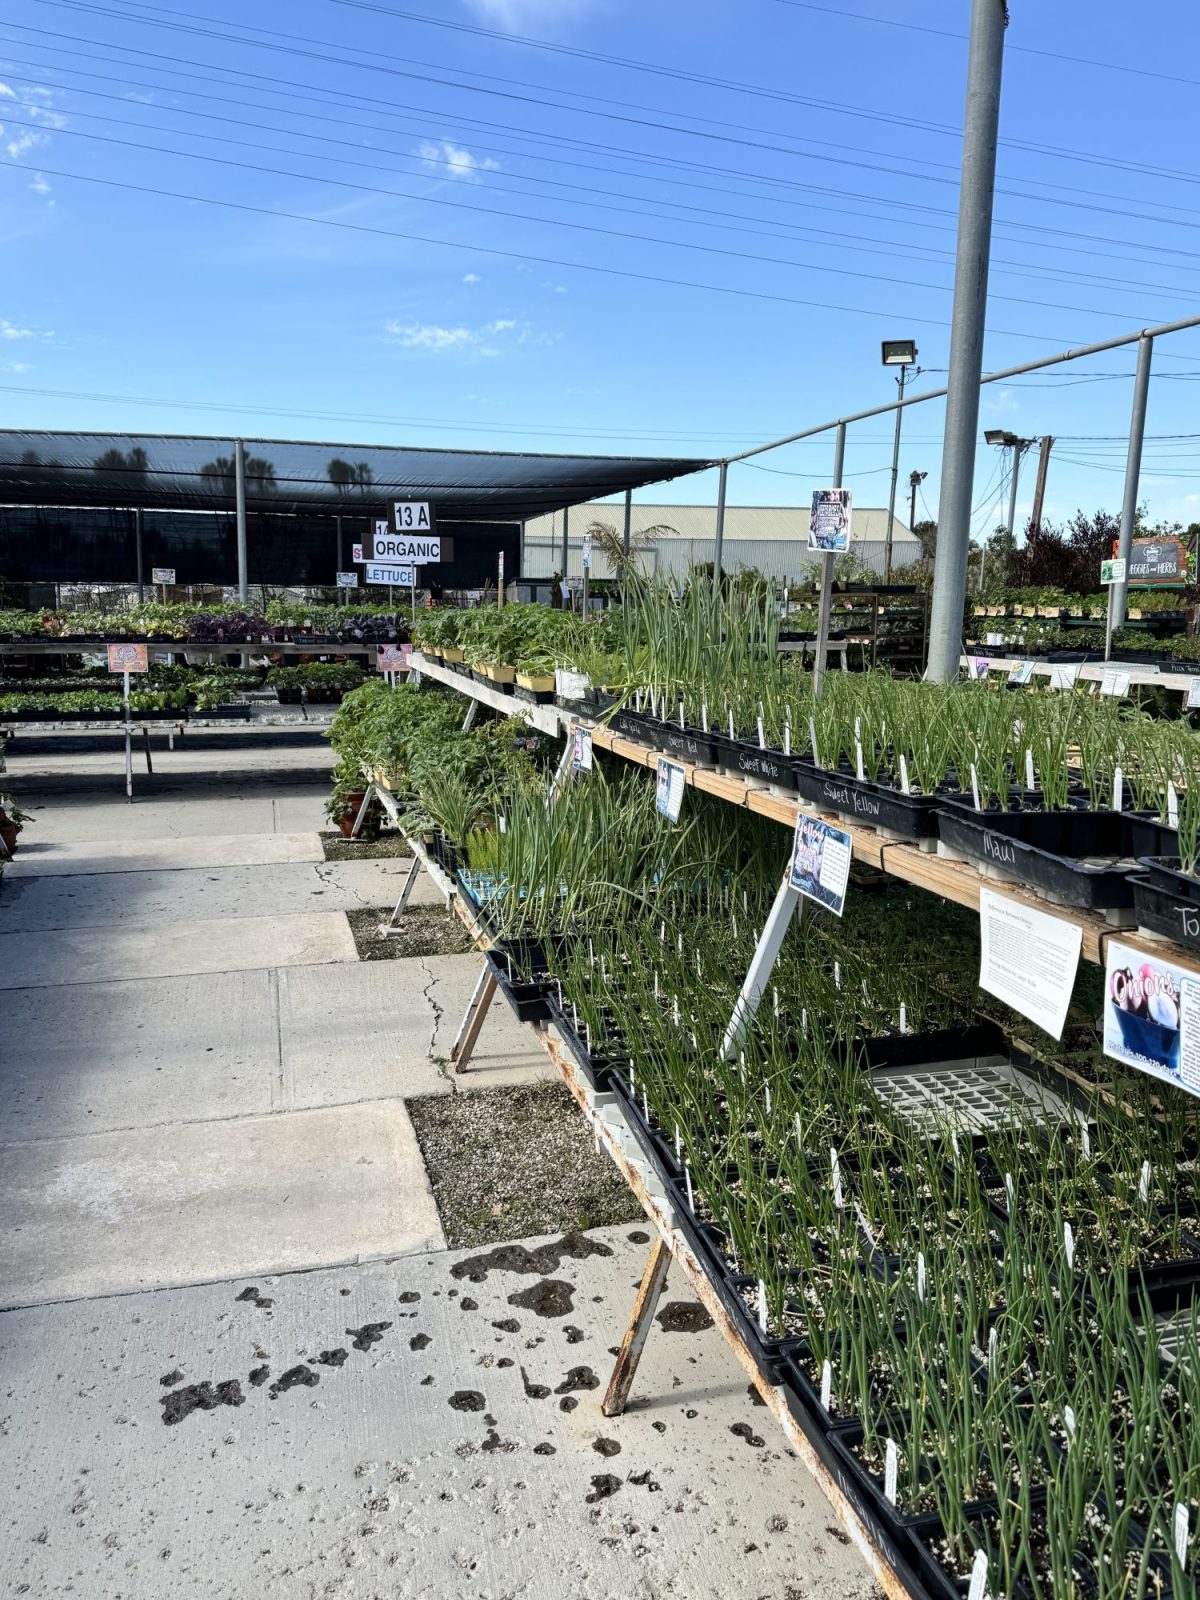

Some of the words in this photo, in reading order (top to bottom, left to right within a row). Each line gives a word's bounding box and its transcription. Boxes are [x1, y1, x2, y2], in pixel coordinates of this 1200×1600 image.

[396, 506, 413, 527] 13
[418, 506, 429, 527] A
[376, 541, 440, 558] ORGANIC
[367, 569, 413, 583] LETTUCE
[1157, 561, 1177, 574] HERBS
[738, 752, 759, 772] Sweet
[823, 781, 850, 804] Sweet
[851, 790, 880, 815] Yellow
[983, 831, 1015, 863] Maui
[1112, 970, 1175, 1003] Onions
